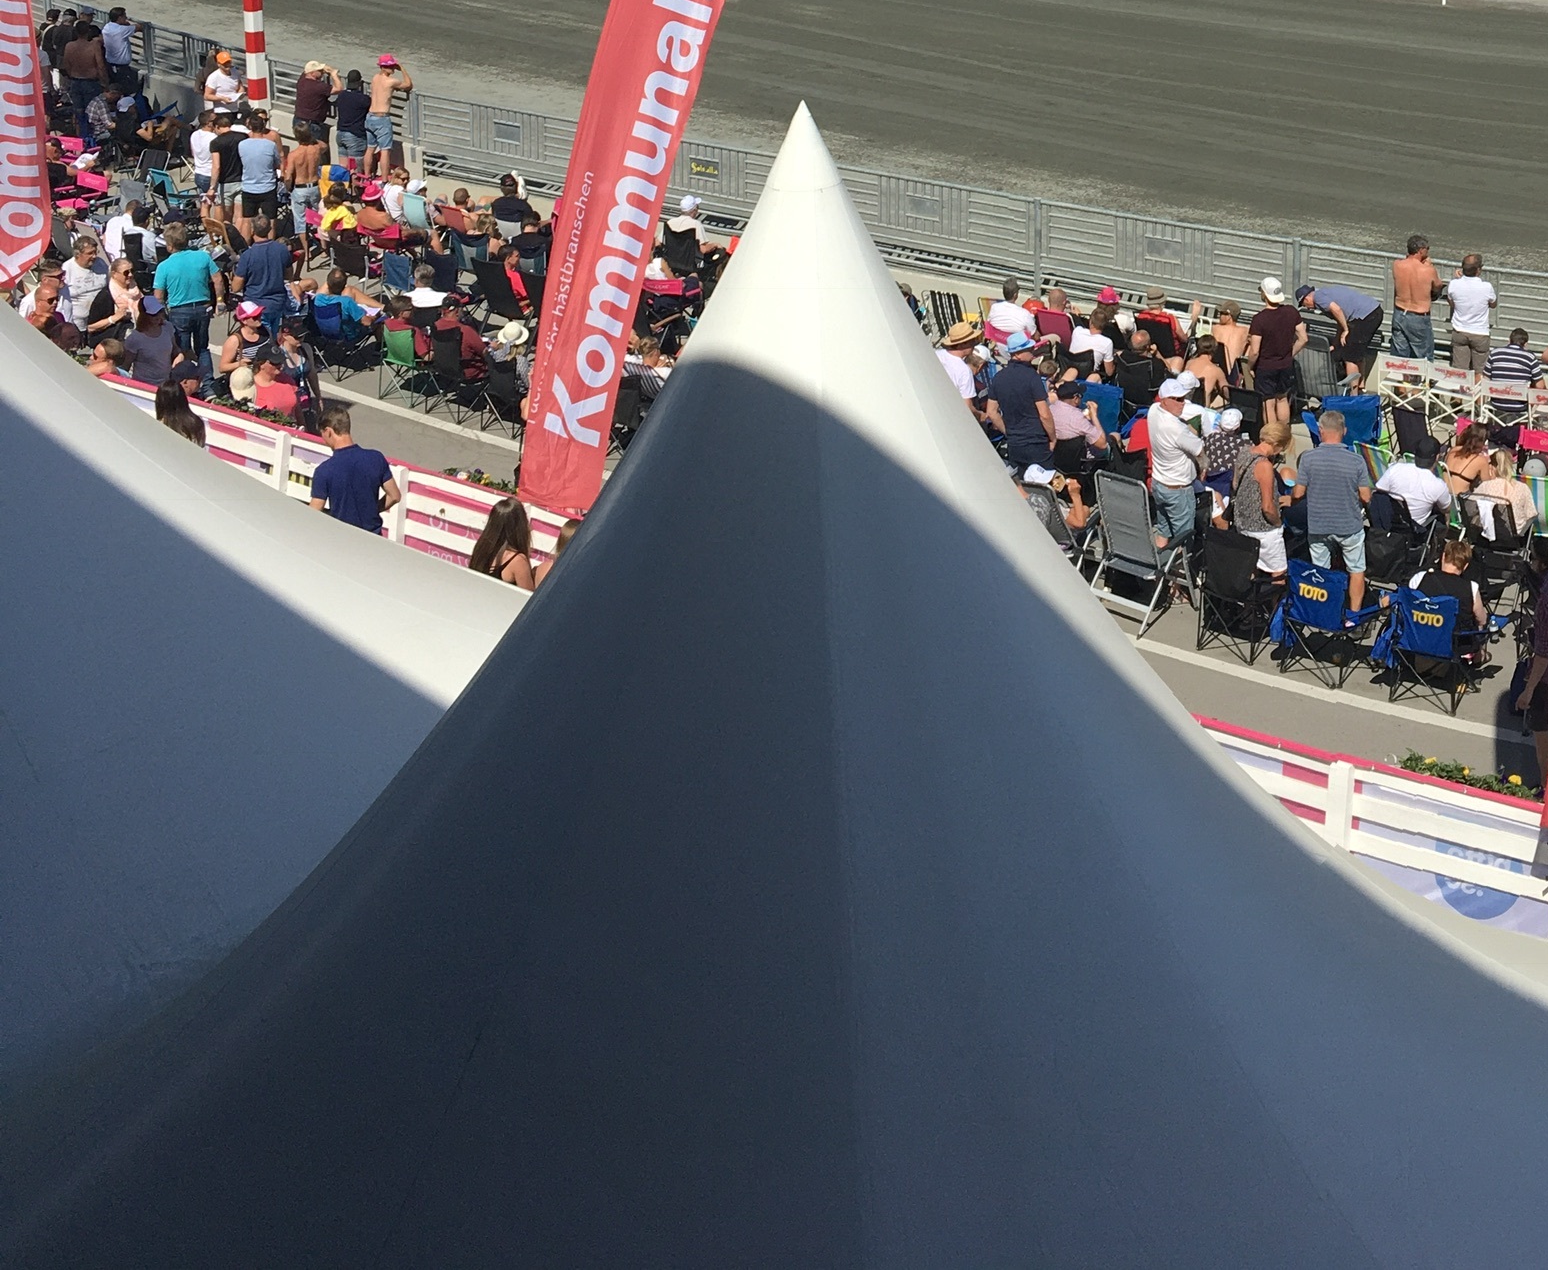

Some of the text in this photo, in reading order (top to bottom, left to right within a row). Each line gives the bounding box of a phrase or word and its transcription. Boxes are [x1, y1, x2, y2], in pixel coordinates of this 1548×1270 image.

[551, 170, 594, 318] hästbranschen
[1299, 583, 1328, 602] TOTO
[1412, 609, 1444, 628] TOTO
